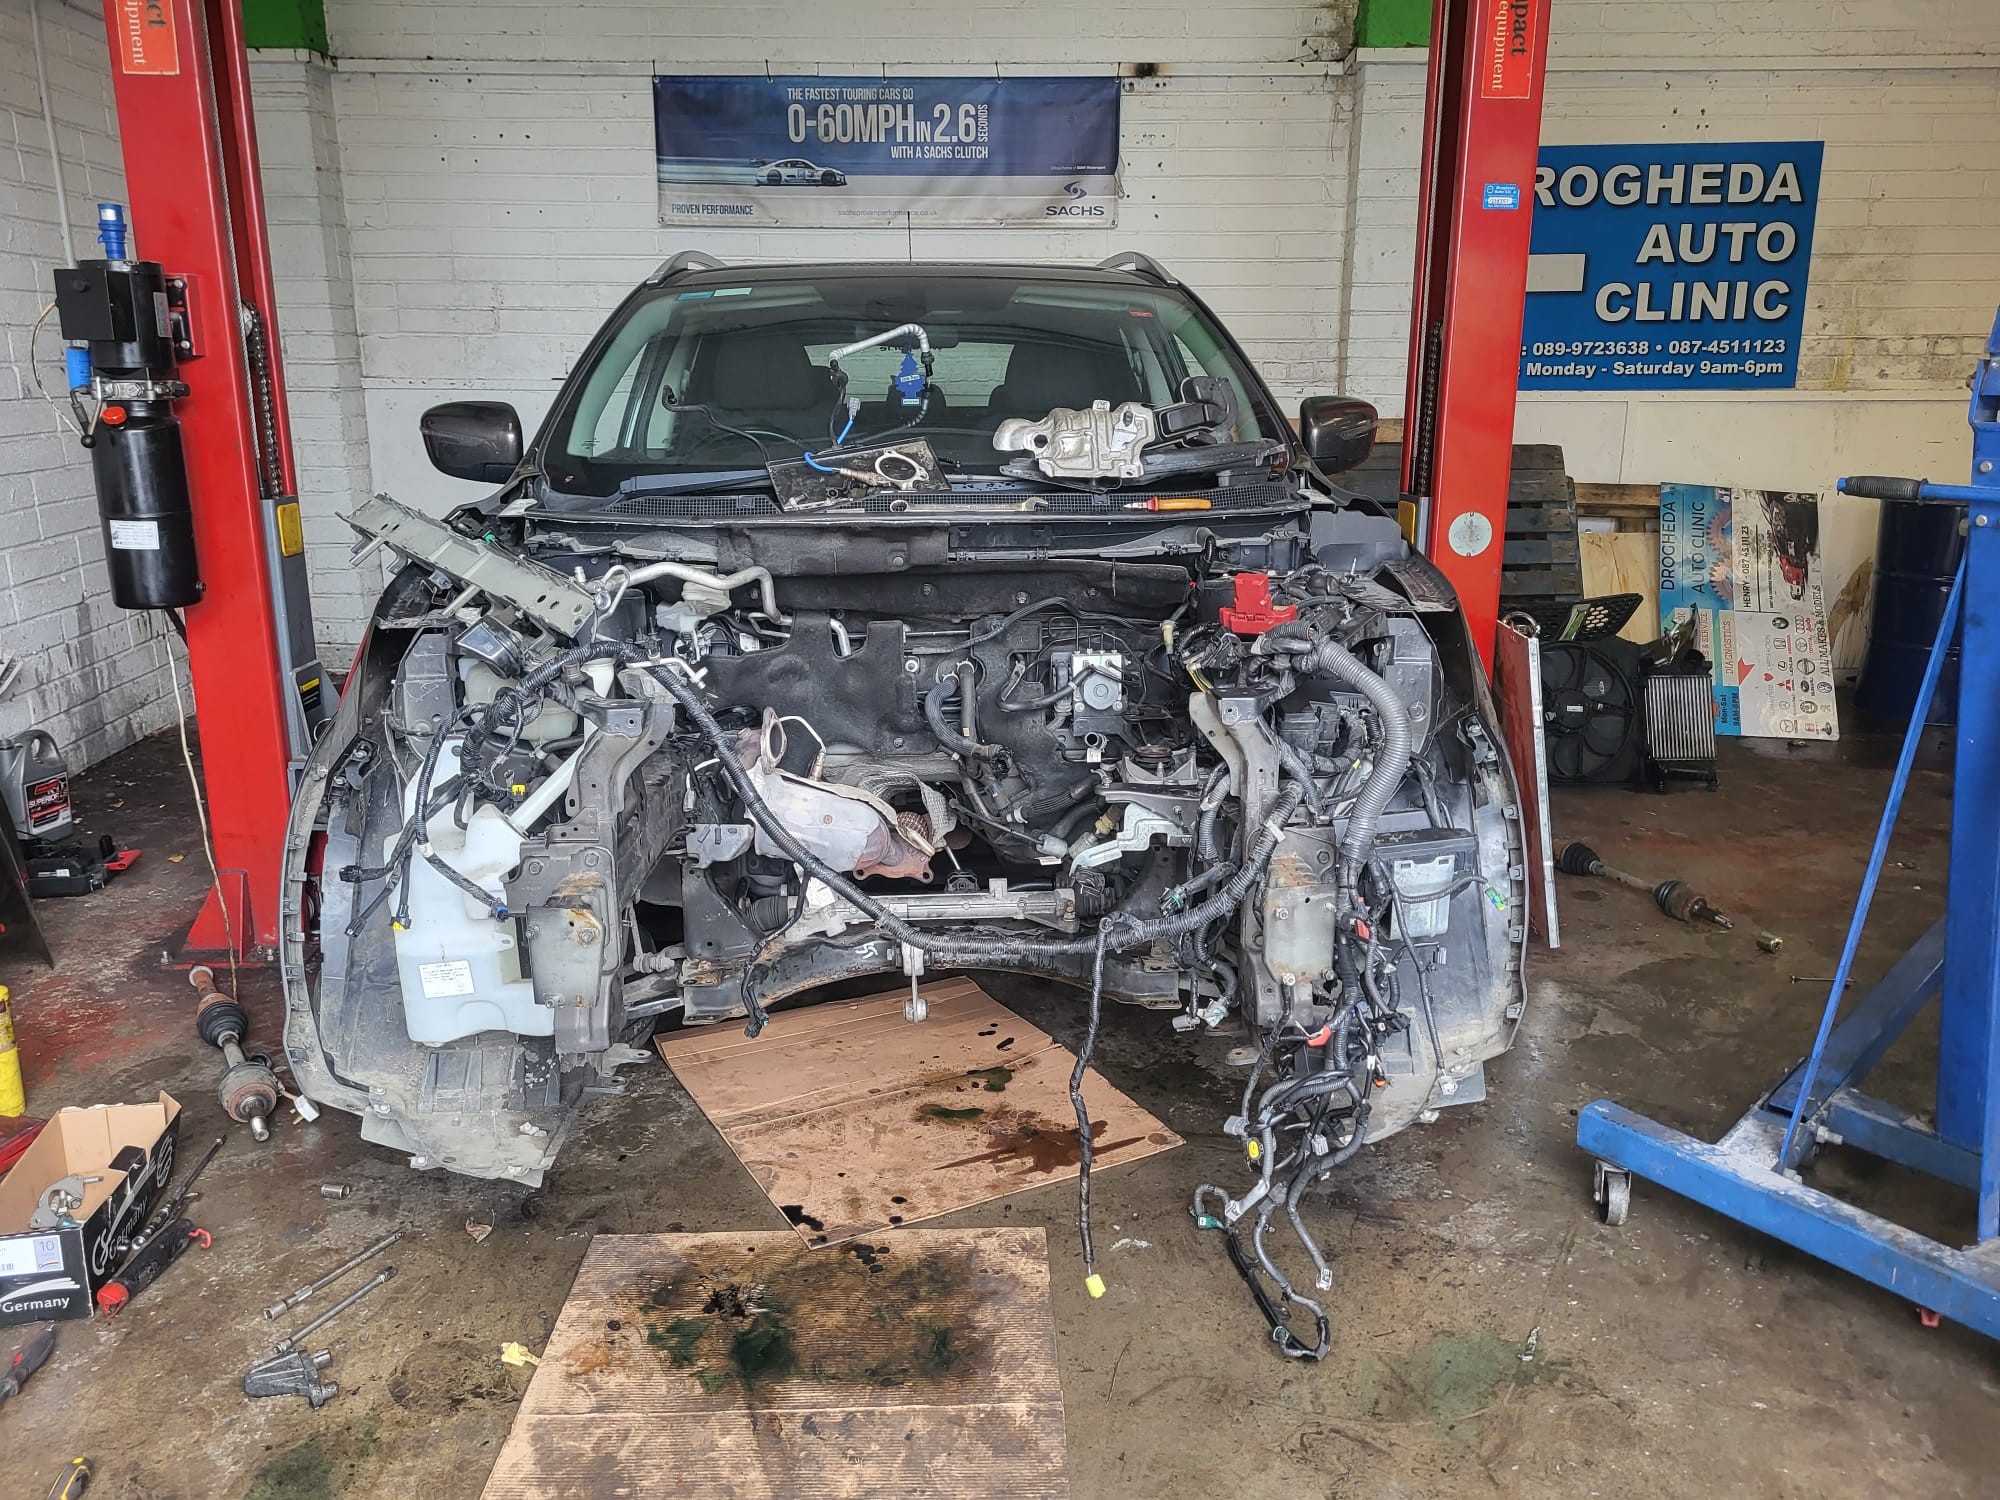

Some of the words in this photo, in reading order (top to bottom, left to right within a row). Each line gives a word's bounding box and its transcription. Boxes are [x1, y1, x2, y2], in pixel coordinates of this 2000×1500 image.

[146, 0, 167, 28] ct
[1510, 0, 1529, 56] pact
[1491, 1, 1509, 91] equipment
[787, 88, 803, 100] THE
[805, 88, 840, 100] FASTEST
[842, 88, 877, 100] TOURING
[879, 88, 901, 100] CARS
[902, 88, 914, 100] GO
[787, 103, 914, 143] 0-60MPH
[916, 121, 930, 143] IN
[933, 103, 976, 143] 2.6
[978, 104, 989, 142] SECONDS
[890, 146, 914, 159] WITH
[915, 146, 922, 159] A
[923, 146, 952, 159] SACHS
[954, 146, 989, 159] CLUTCH
[671, 203, 700, 214] PROVEN
[701, 204, 754, 215] PERFORMANCE
[1045, 205, 1105, 216] SACHS
[1636, 221, 1797, 264] AUTO
[1594, 280, 1790, 322] CLINIC
[1532, 341, 1649, 356] 089-9723638
[1668, 339, 1786, 355] 087-4511123
[1526, 362, 1596, 379] Monday
[1612, 360, 1694, 378] Saturday
[1699, 359, 1784, 377] 9am-6pm
[1691, 502, 1705, 549] CLINIC
[1661, 501, 1676, 590] DROGHEDA
[1691, 552, 1705, 594] AUTO
[1742, 580, 1752, 608] HENRY
[1811, 584, 1824, 618] MODELS
[1700, 612, 1709, 642] SERVICE
[1816, 627, 1828, 657] MAKES
[1723, 620, 1734, 675] DIAGNOSTICS
[1820, 659, 1830, 676] ALL
[39, 1240, 55, 1252] 10
[2, 1297, 70, 1313] Germany
